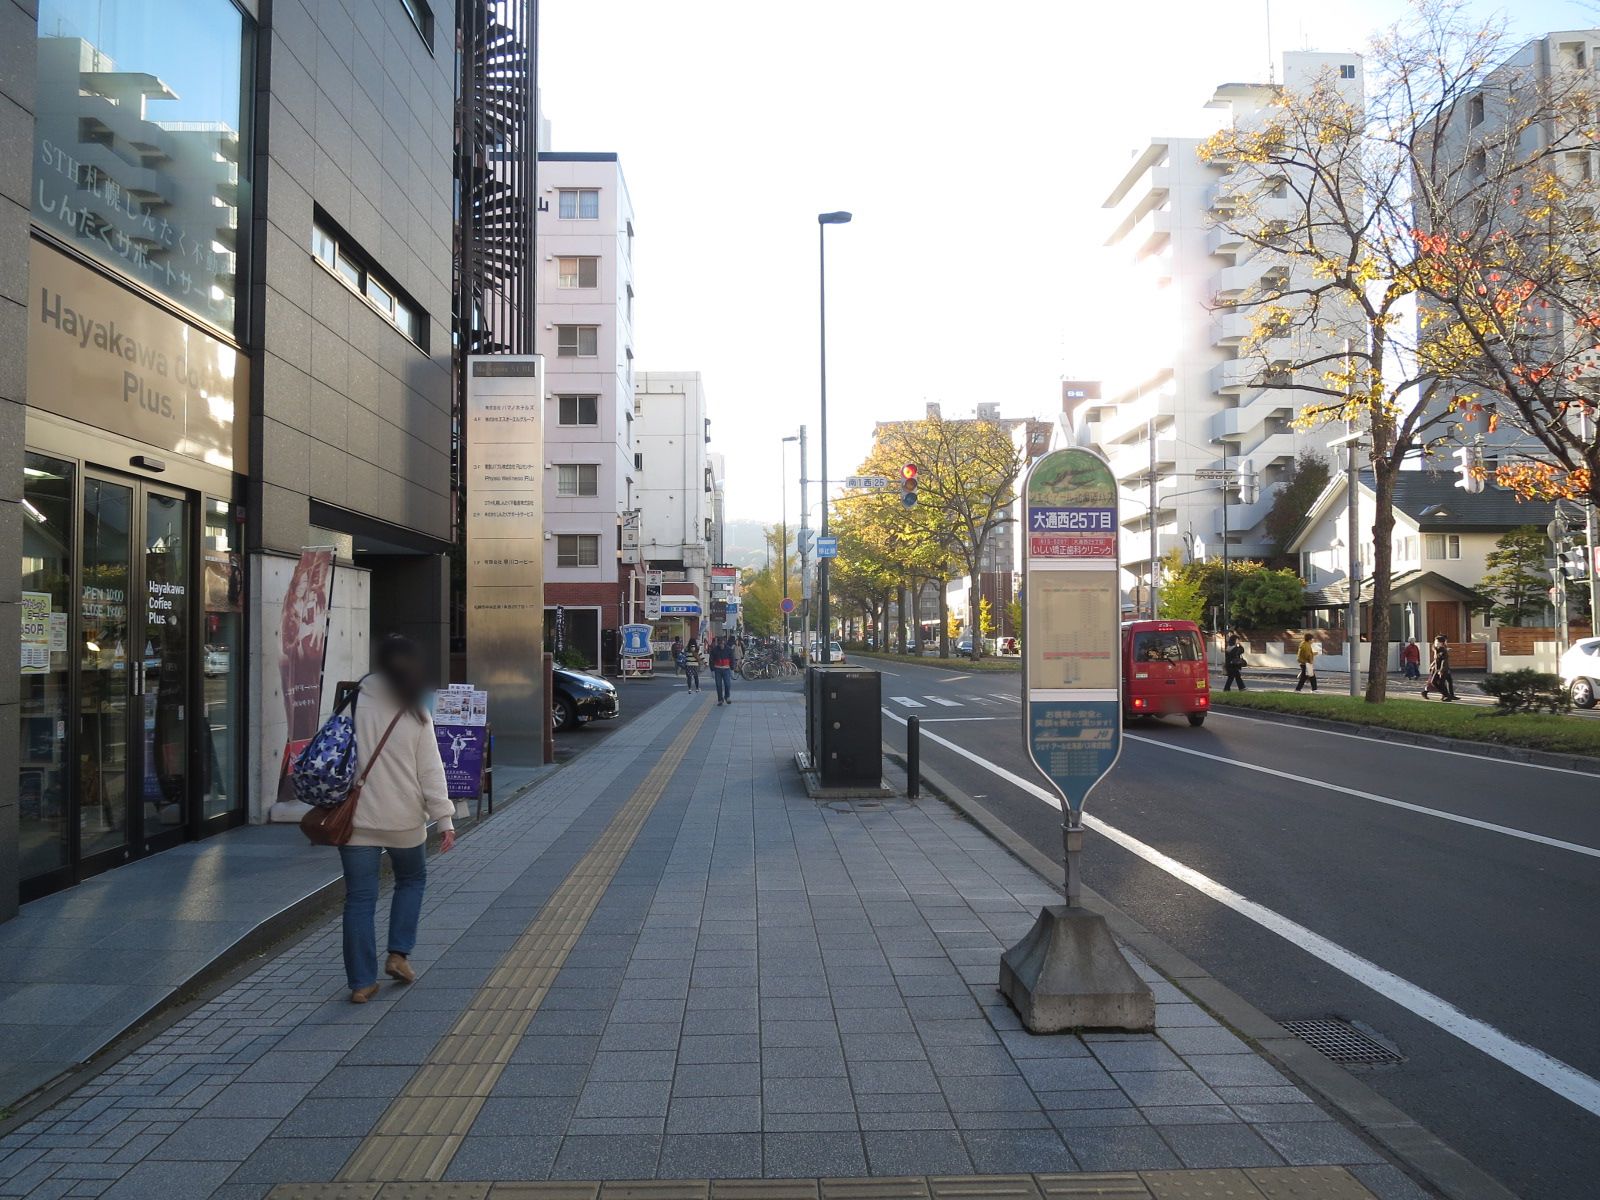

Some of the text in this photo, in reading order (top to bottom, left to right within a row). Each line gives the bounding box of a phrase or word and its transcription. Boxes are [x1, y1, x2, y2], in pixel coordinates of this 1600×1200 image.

[42, 139, 229, 275] STH札幌しんたく不動
[39, 178, 223, 314] しんたくサポートサー
[42, 287, 168, 378] Hayakawa
[123, 371, 176, 420] Plus.
[1033, 511, 1112, 529] 大通西25丁目
[1032, 545, 1112, 555] いしい矯正歯科クリニック
[148, 596, 173, 610] Coffee
[149, 581, 185, 595] Hayakawa
